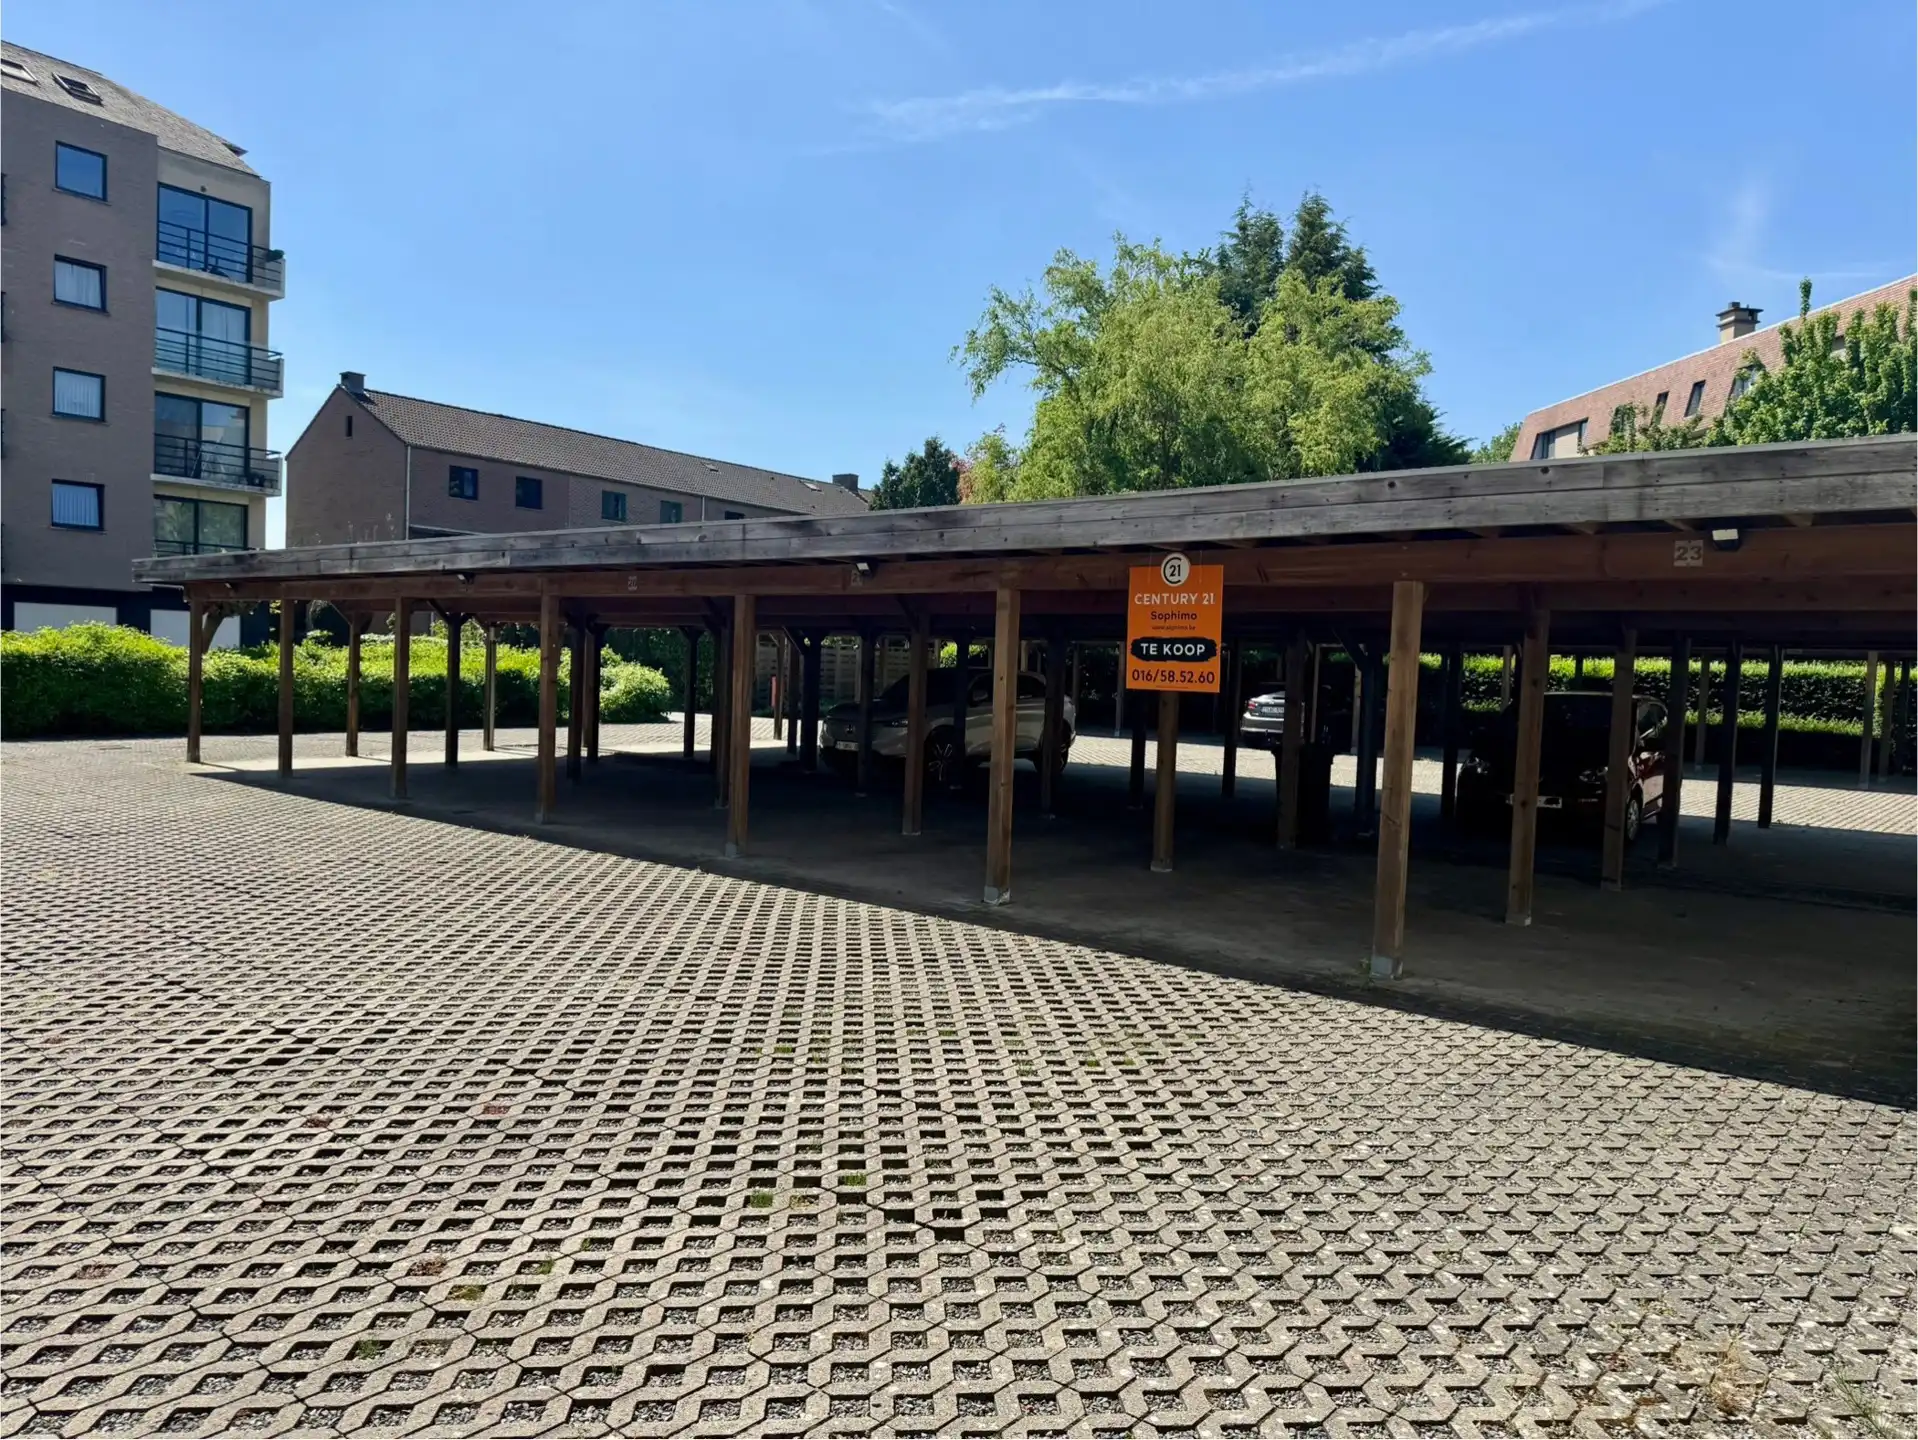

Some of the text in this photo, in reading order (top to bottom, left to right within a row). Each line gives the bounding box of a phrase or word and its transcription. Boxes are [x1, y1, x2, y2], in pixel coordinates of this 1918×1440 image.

[1676, 546, 1702, 561] 23
[1169, 565, 1181, 577] 21
[1134, 593, 1215, 605] CENTURY 21
[1150, 611, 1197, 622] Sophimo
[1141, 643, 1206, 656] TE KOOP
[1132, 669, 1215, 684] 016/58.52.60
